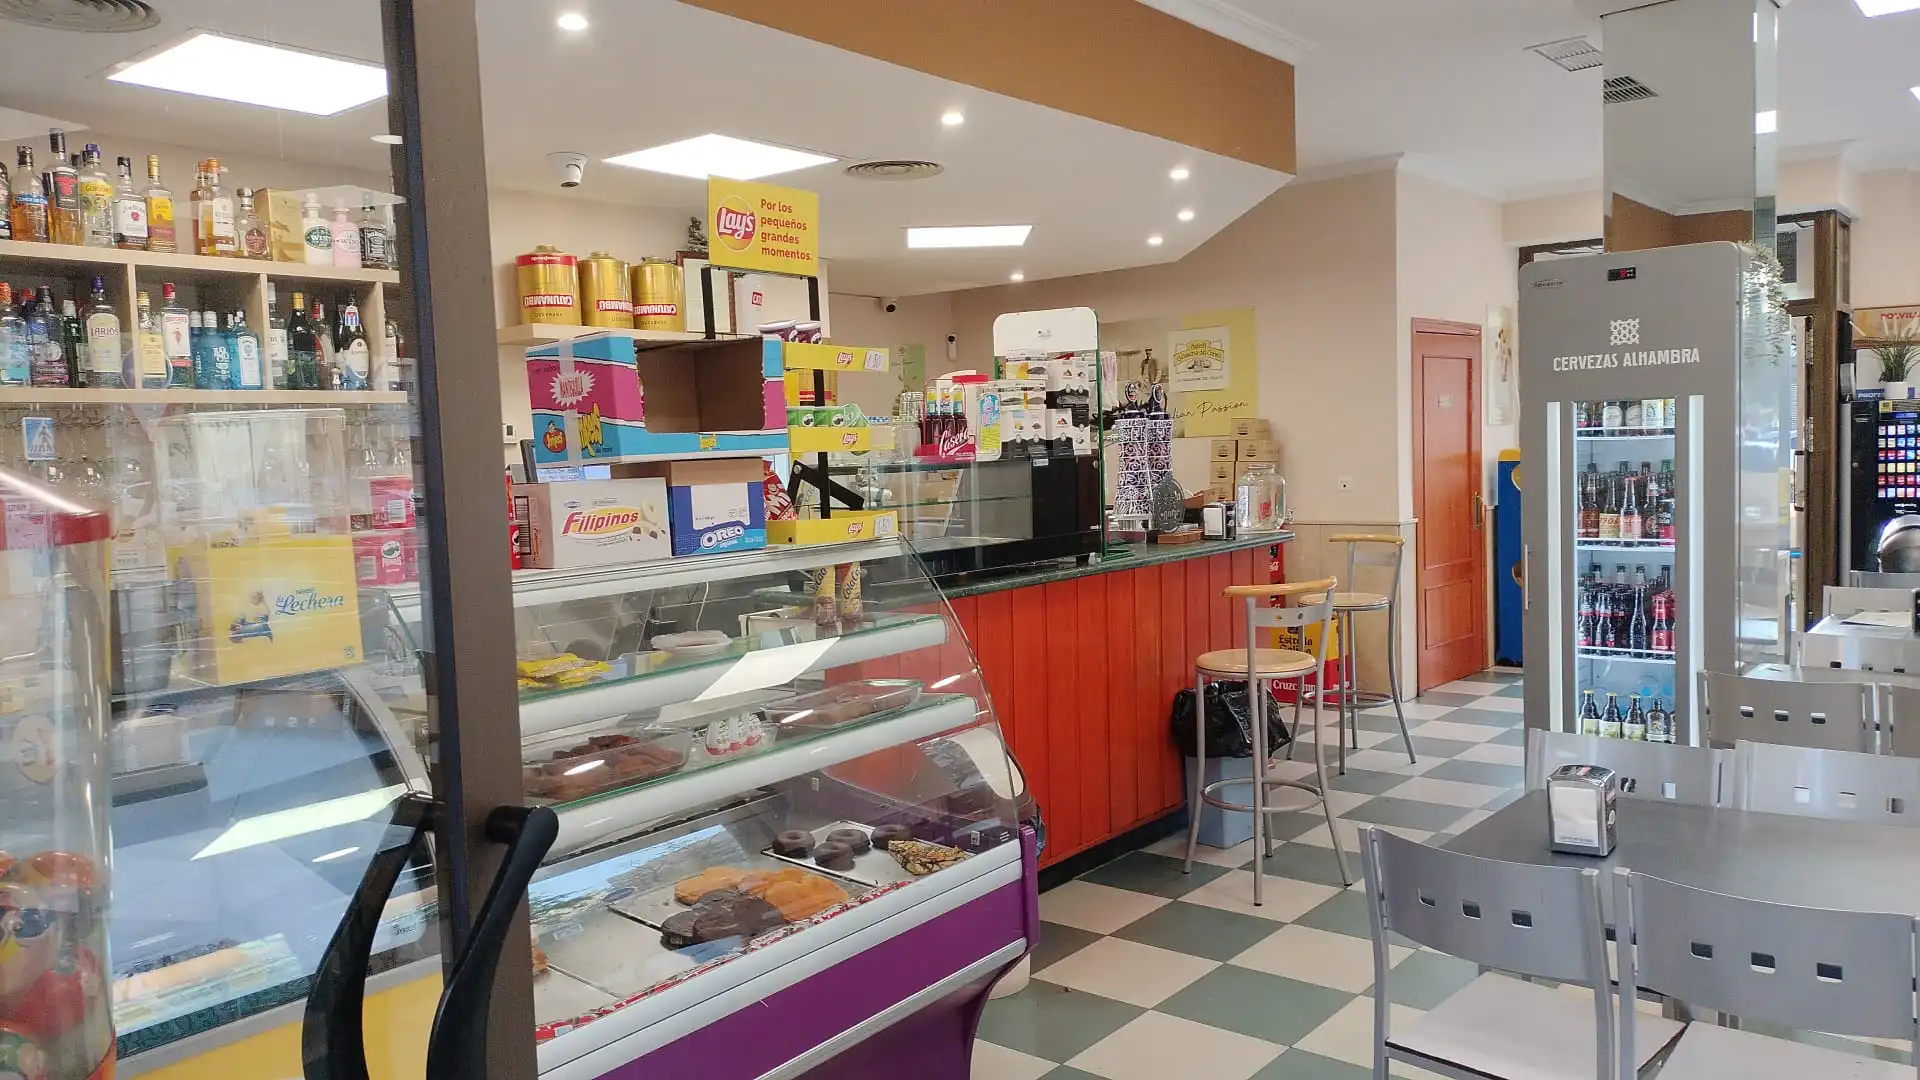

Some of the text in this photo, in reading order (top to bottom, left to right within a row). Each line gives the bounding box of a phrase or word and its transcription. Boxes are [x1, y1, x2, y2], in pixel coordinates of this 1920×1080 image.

[760, 198, 793, 213] Por los
[718, 207, 755, 240] Lay's
[760, 215, 808, 231] pequeños
[760, 231, 800, 245] grandes
[761, 247, 813, 261] momentos.
[90, 326, 120, 338] LARIOS
[1553, 348, 1701, 372] CERVEZAS ALHAMBRA
[1197, 400, 1249, 419] Passion
[561, 510, 640, 536] Filipinos
[701, 526, 745, 549] OREO
[275, 592, 345, 616] Lechera
